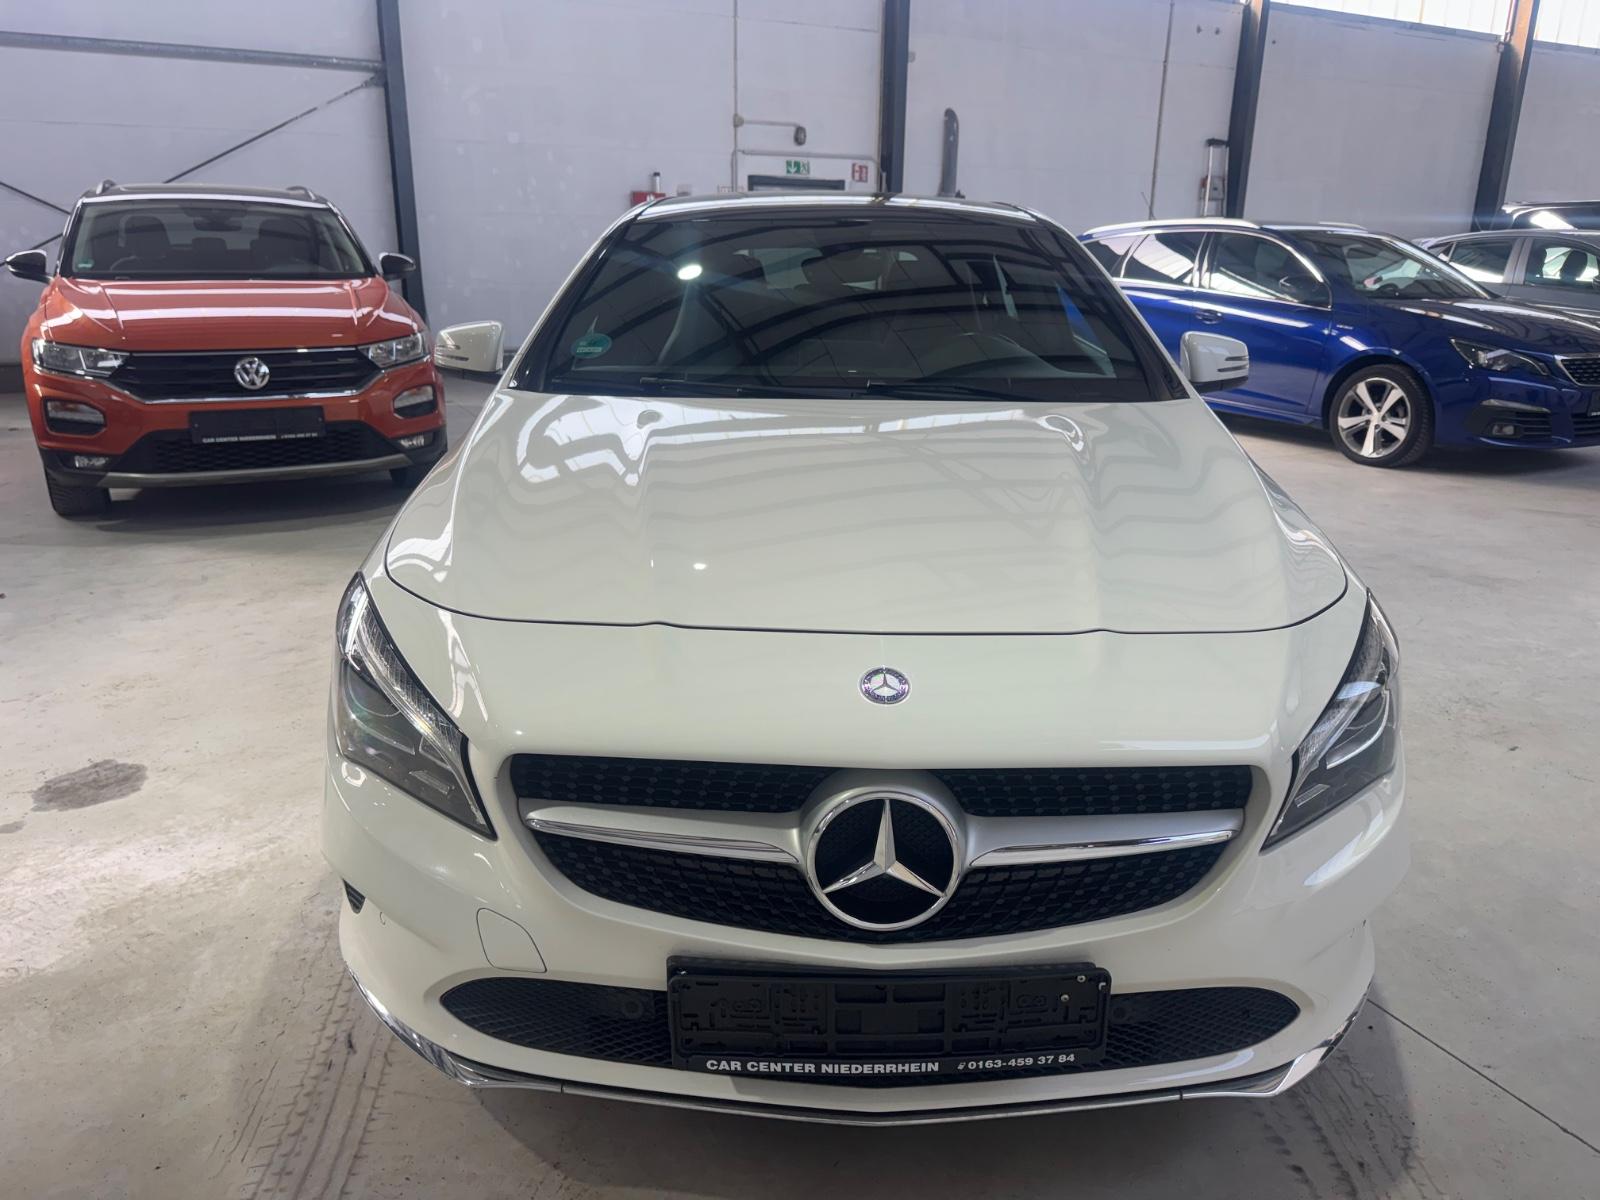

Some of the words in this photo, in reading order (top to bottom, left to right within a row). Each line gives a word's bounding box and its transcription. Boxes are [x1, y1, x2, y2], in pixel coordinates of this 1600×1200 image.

[706, 1059, 742, 1072] CAR
[746, 1061, 816, 1073] CENTER
[821, 1062, 939, 1074] NIEDERRHEIN
[967, 1057, 1034, 1070] 0163-459
[1037, 1055, 1055, 1065] 37
[1058, 1053, 1076, 1063] 84
